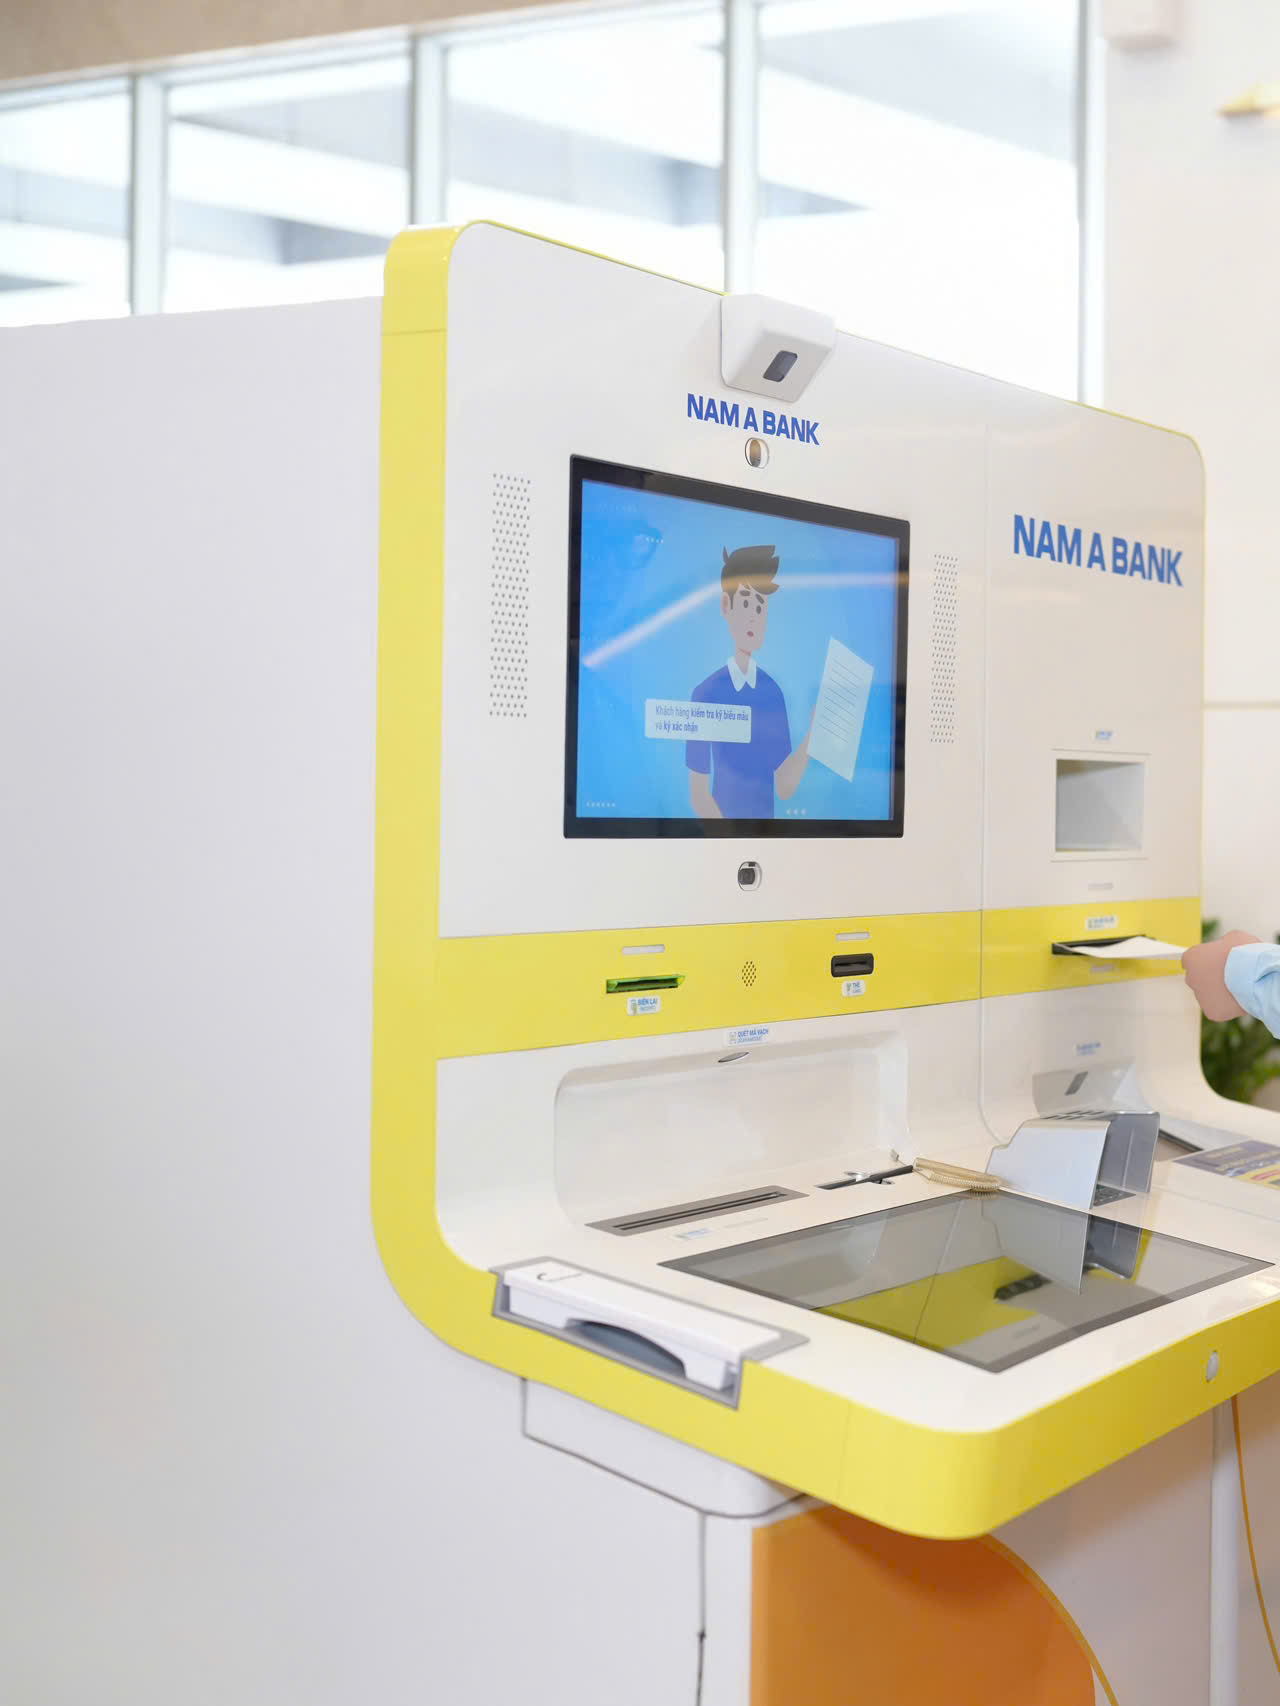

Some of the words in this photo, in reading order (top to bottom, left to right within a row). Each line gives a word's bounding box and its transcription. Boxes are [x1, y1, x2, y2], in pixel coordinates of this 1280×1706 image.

[687, 392, 740, 428] NAM
[743, 406, 759, 432] A
[762, 409, 820, 446] BANK
[1014, 513, 1082, 567] NAM
[1087, 531, 1106, 572] A
[1112, 536, 1183, 587] BANK
